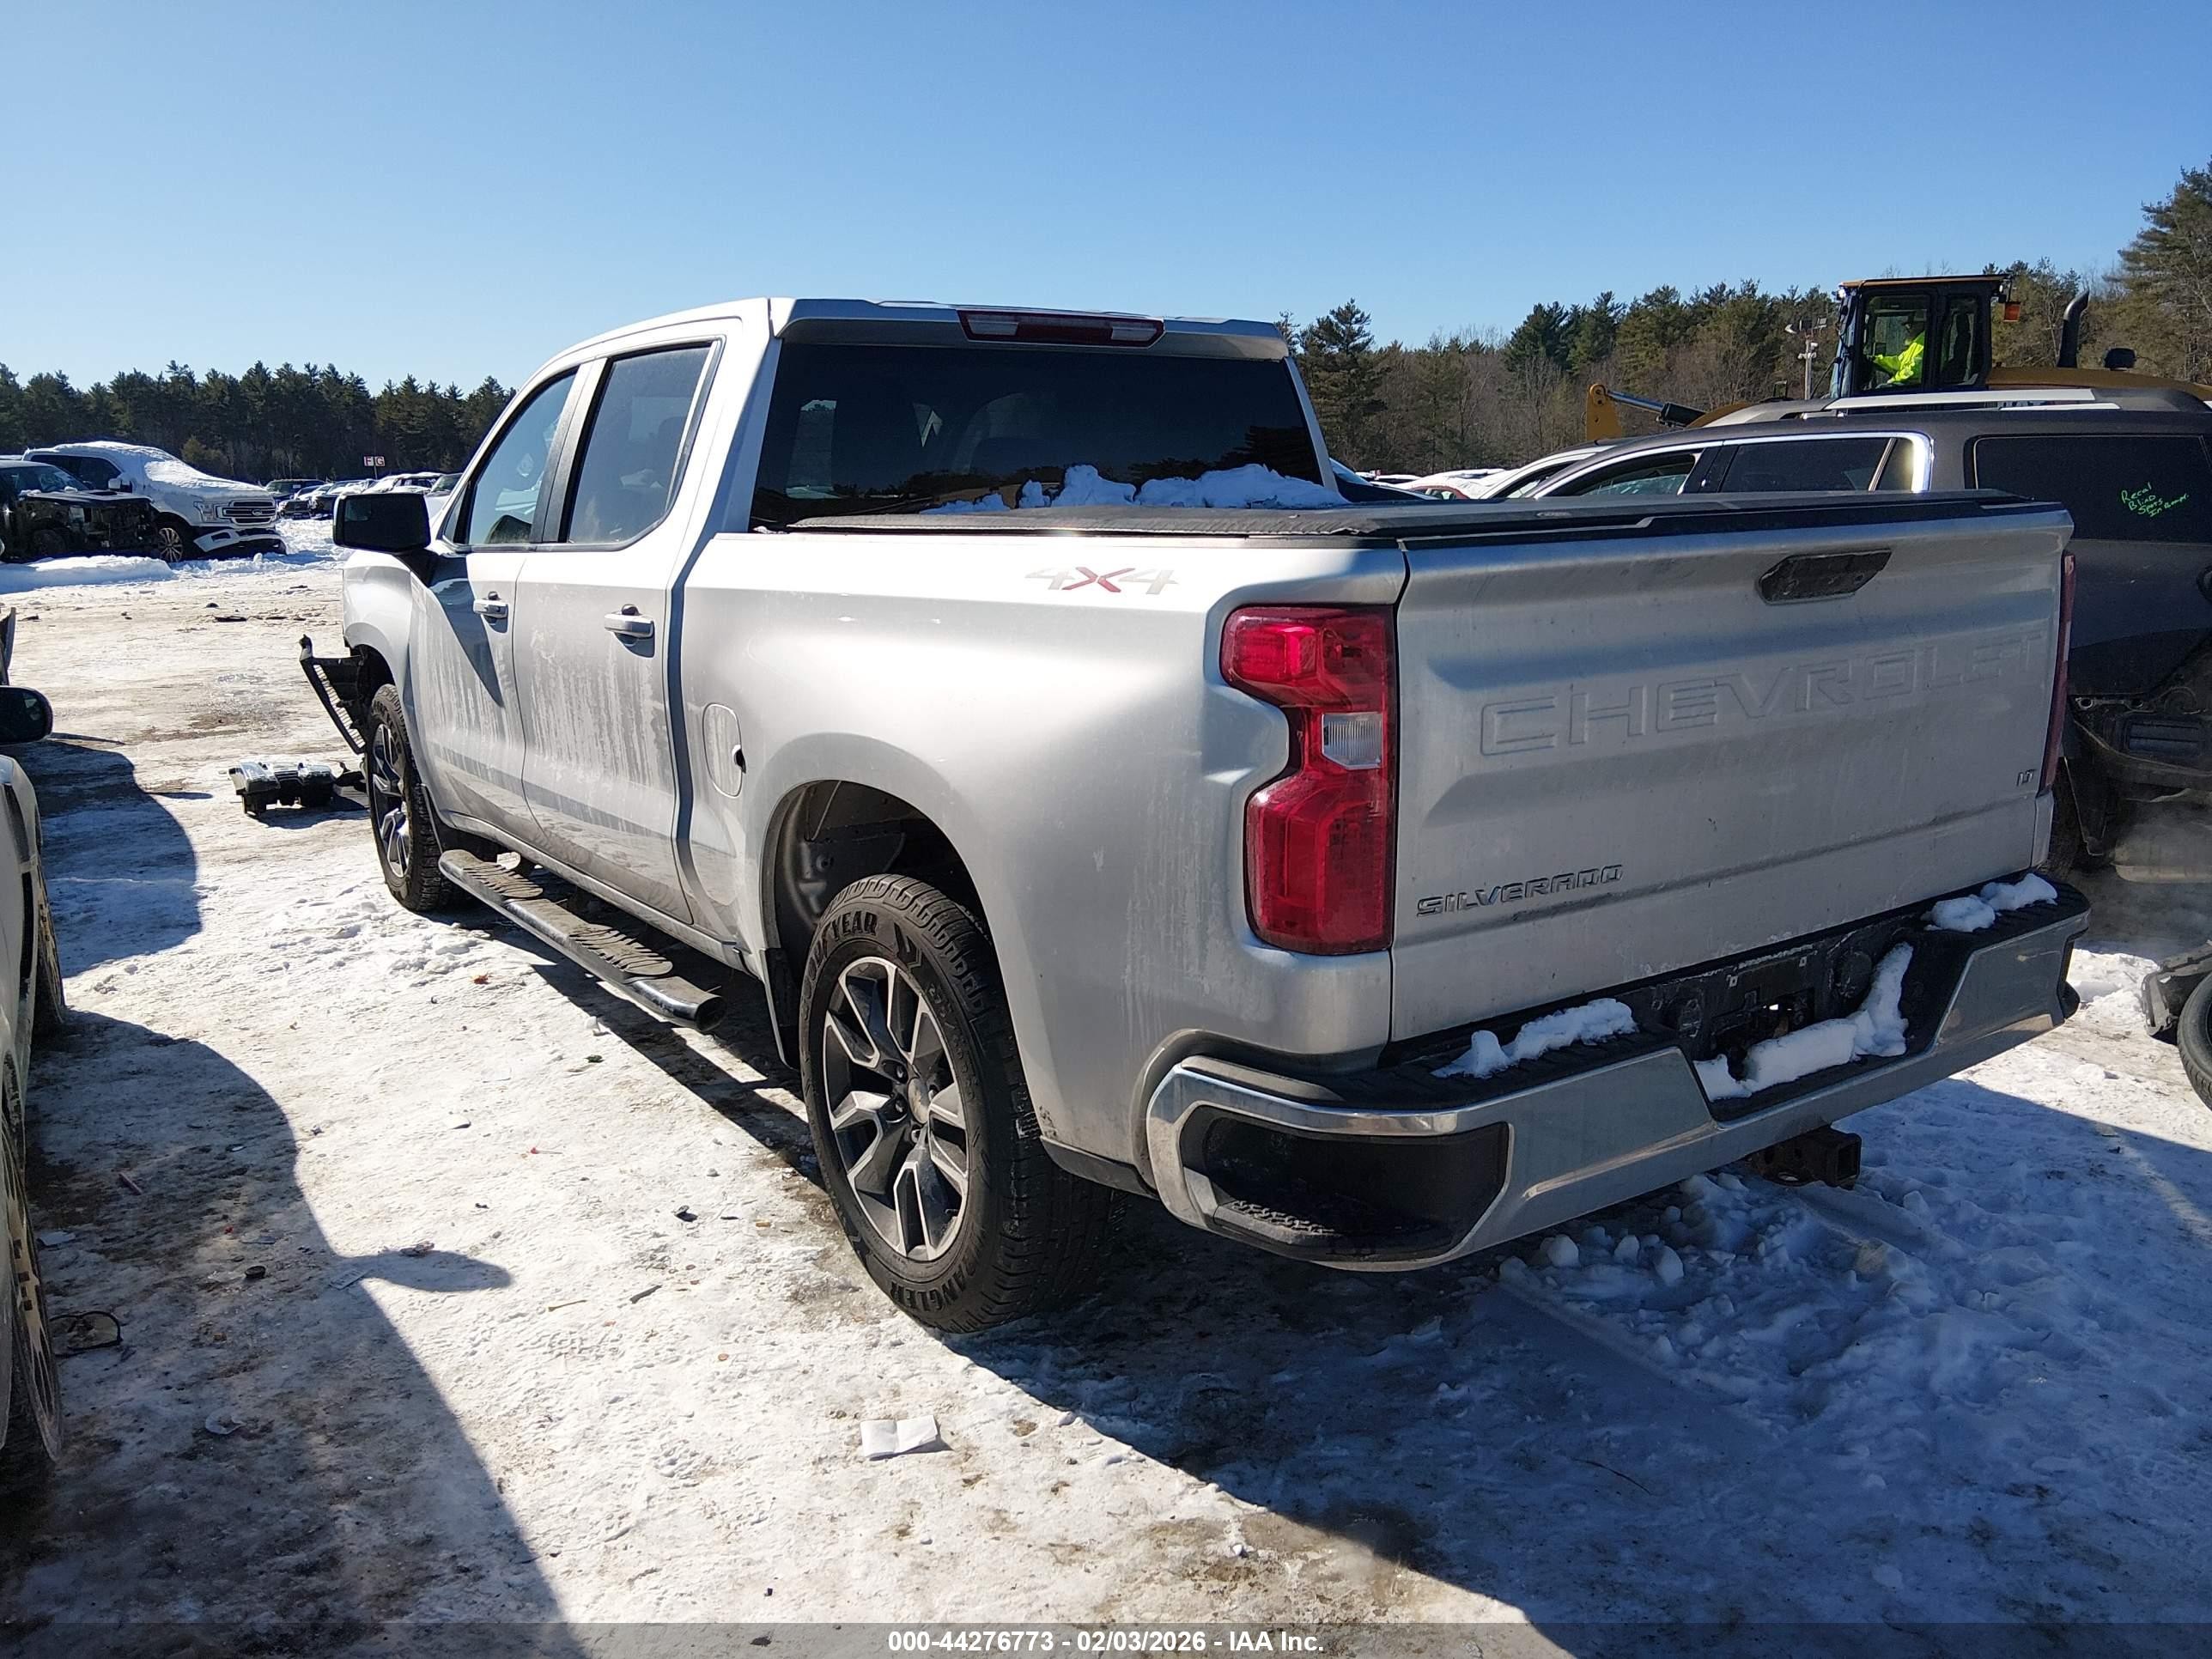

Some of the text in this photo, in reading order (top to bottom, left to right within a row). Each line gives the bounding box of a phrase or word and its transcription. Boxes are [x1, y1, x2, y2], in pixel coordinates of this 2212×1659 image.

[1480, 629, 2042, 757] CHEVROLET
[2016, 769, 2037, 787] LT
[1416, 864, 1623, 917] SILVERADO
